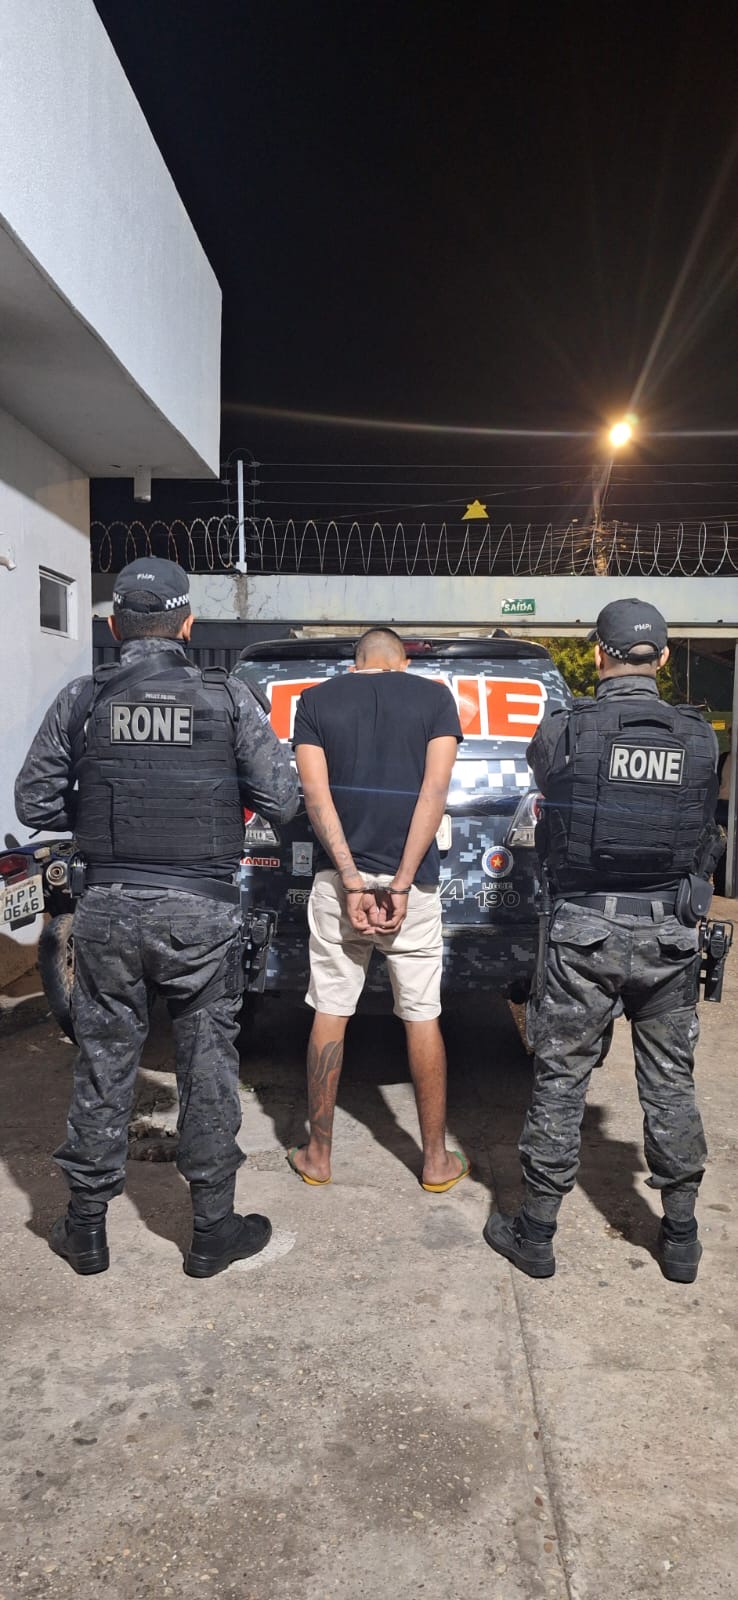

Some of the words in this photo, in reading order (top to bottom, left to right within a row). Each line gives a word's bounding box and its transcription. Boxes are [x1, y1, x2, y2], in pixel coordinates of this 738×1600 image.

[504, 601, 533, 612] SAÍDA
[113, 706, 190, 741] RONE
[611, 748, 682, 781] RONE
[5, 885, 37, 907] HPP
[475, 890, 521, 908] 190
[3, 898, 40, 921] 0646
